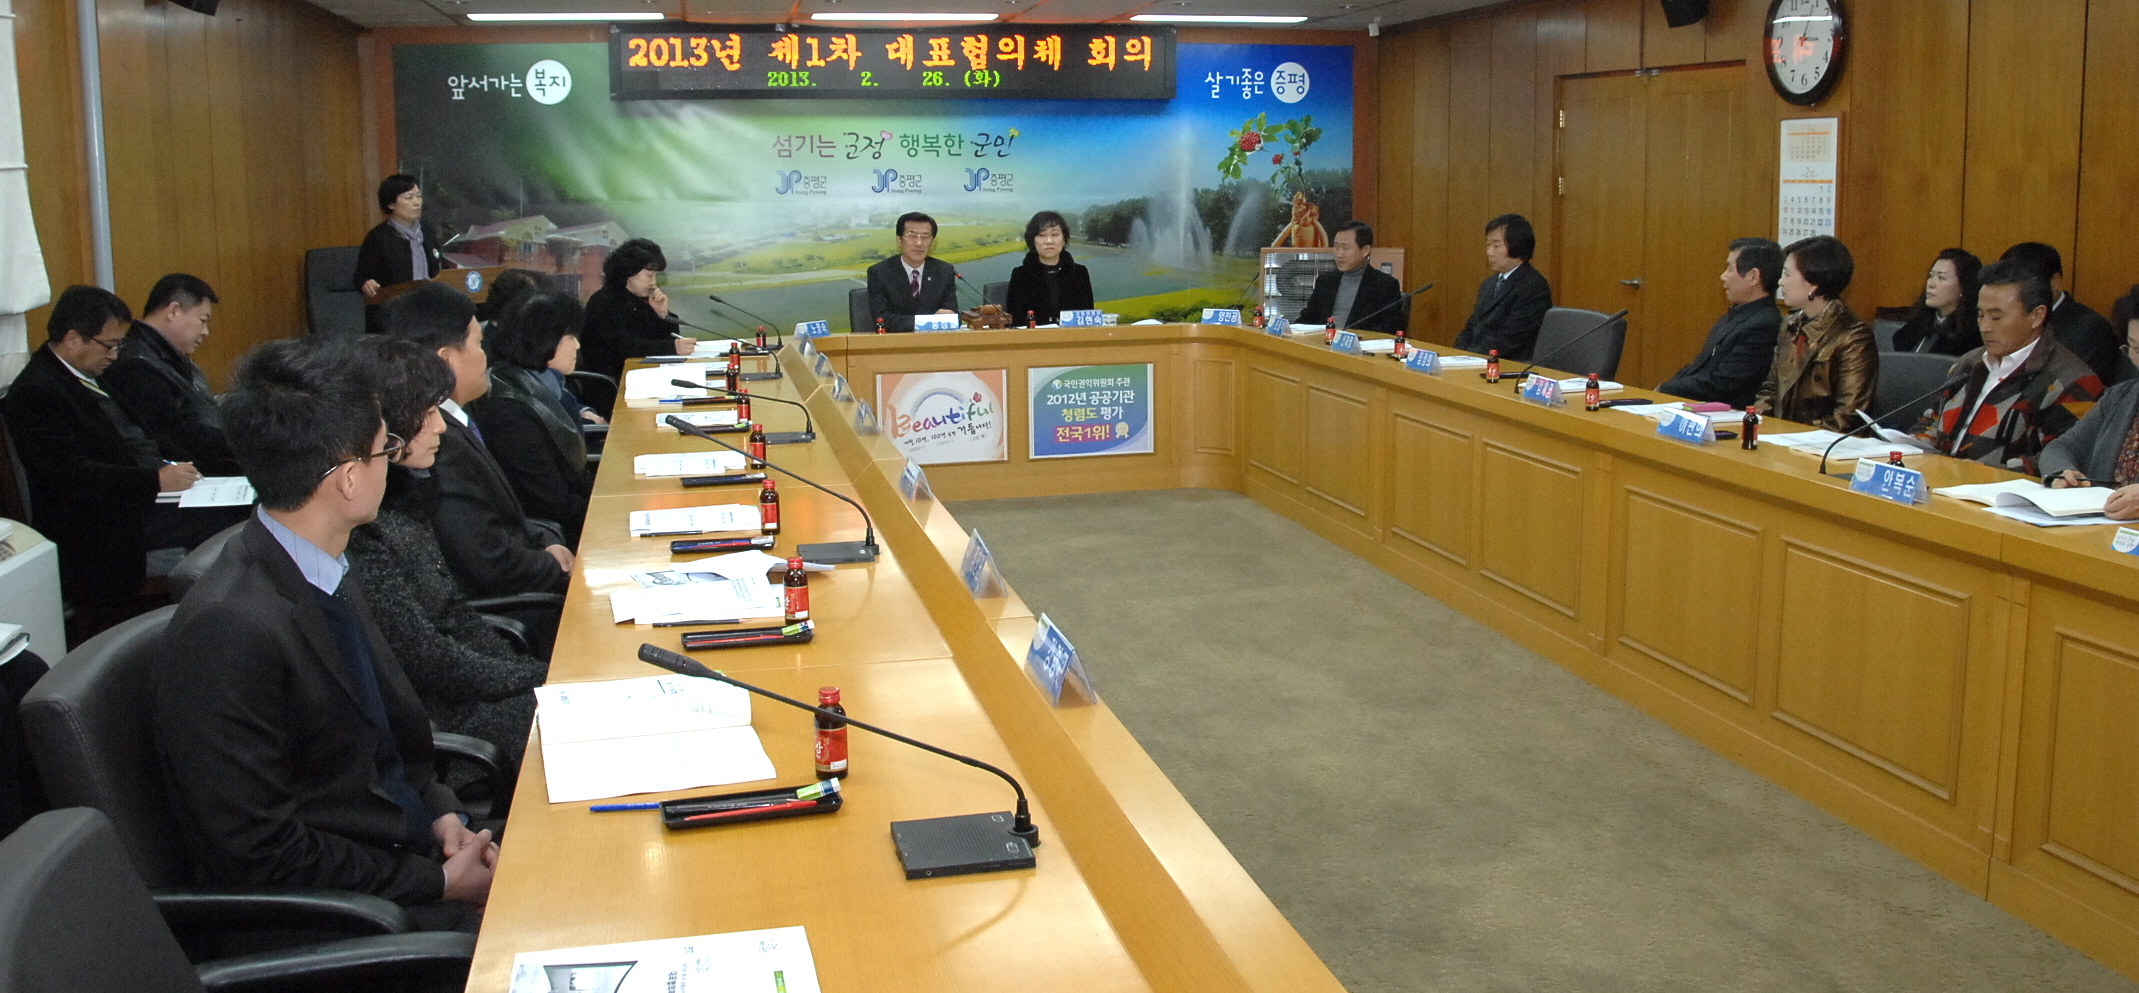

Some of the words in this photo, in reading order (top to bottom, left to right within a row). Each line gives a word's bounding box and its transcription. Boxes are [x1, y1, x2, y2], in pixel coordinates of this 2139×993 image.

[628, 33, 742, 71] 2013년
[768, 33, 862, 70] 제1차
[885, 34, 1062, 71] 대표협의체
[1087, 35, 1152, 71] 회의
[1822, 50, 1829, 63] 4
[767, 71, 817, 87] 2013.
[860, 71, 879, 87] 2.
[922, 71, 951, 87] 26.
[964, 70, 1001, 87] (화)
[1790, 69, 1796, 83] 7
[1801, 73, 1808, 86] 6
[1814, 66, 1820, 80] 5
[447, 73, 523, 100] 앞서가는
[534, 69, 566, 97] 복지
[1204, 68, 1265, 99] 살기좋은
[1275, 70, 1305, 95] 증평
[772, 134, 836, 158] 섬기는
[843, 132, 886, 160] 군정
[899, 133, 964, 158] 행복한
[970, 132, 1015, 158] 군민
[803, 176, 827, 189] 증평군
[899, 174, 922, 188] 증평군
[990, 173, 1014, 187] 증평군
[1063, 378, 1114, 389] 국민권익위원회
[1115, 377, 1131, 387] 주관
[1046, 392, 1087, 406] 2012년
[1089, 389, 1135, 405] 공공기관
[887, 402, 994, 439] Beautiful
[1061, 407, 1098, 422] 청렴도
[1100, 405, 1124, 420] 평가
[1056, 424, 1110, 442] 전국1위!
[1881, 469, 1916, 498] 안복순
